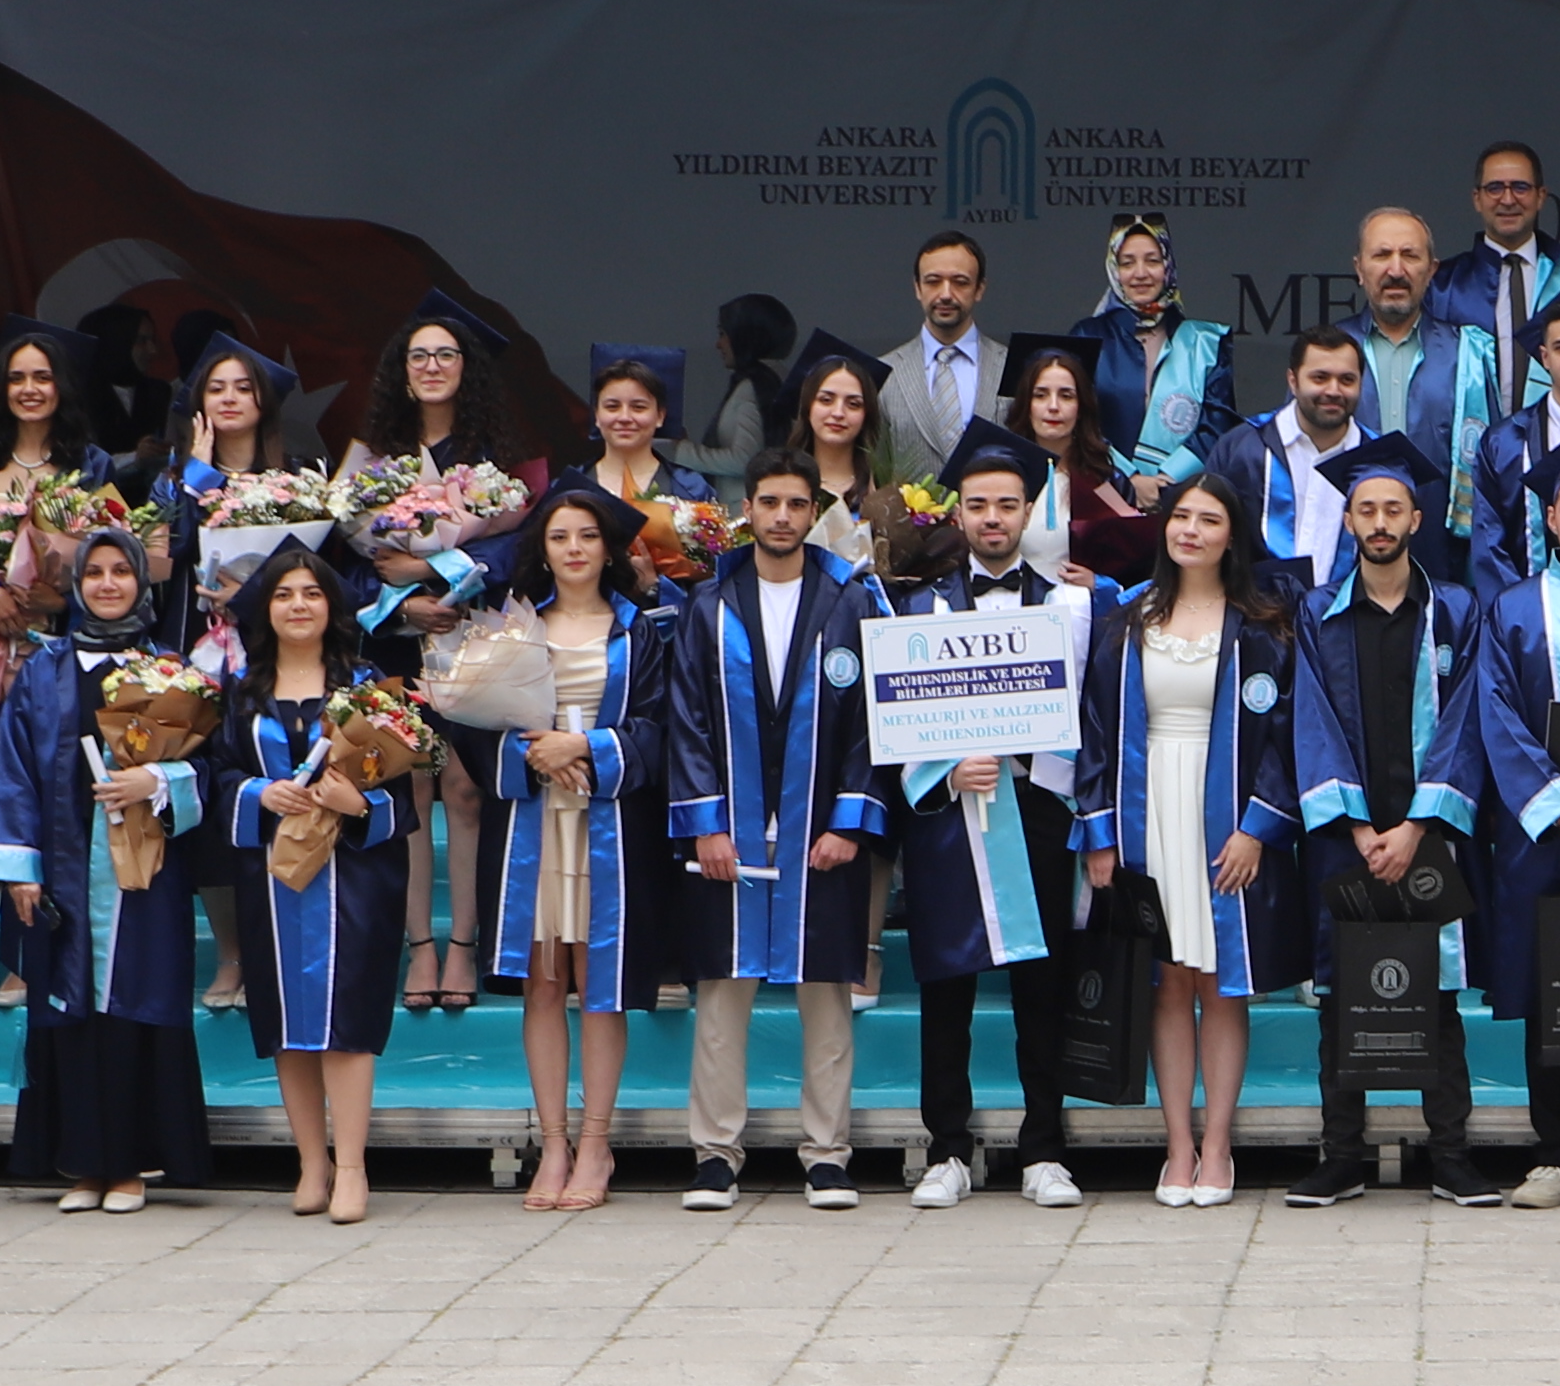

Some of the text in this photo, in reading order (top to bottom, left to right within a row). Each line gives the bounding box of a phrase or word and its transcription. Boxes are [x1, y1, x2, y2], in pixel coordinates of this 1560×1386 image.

[817, 127, 937, 149] ANKARA
[1044, 127, 1164, 149] ANKARA
[673, 155, 938, 177] YILDIRIM BEYAZIT
[1045, 156, 1310, 179] YILDIRIM BEYAZIT
[759, 184, 937, 206] UNIVERSITY
[1044, 180, 1248, 208] ÜNİVERSİTESİ
[963, 206, 1019, 224] AYBÜ
[936, 625, 1028, 661] AYBÜ
[888, 663, 1052, 688] MÜHENDİSLİK VE DOĞA
[895, 677, 1046, 700] BİLİMLERİ FAKÜLTESİ
[882, 702, 1065, 727] METALURJİ VE MALZEME
[917, 722, 1032, 742] MÜHENDİSLİĞİ
